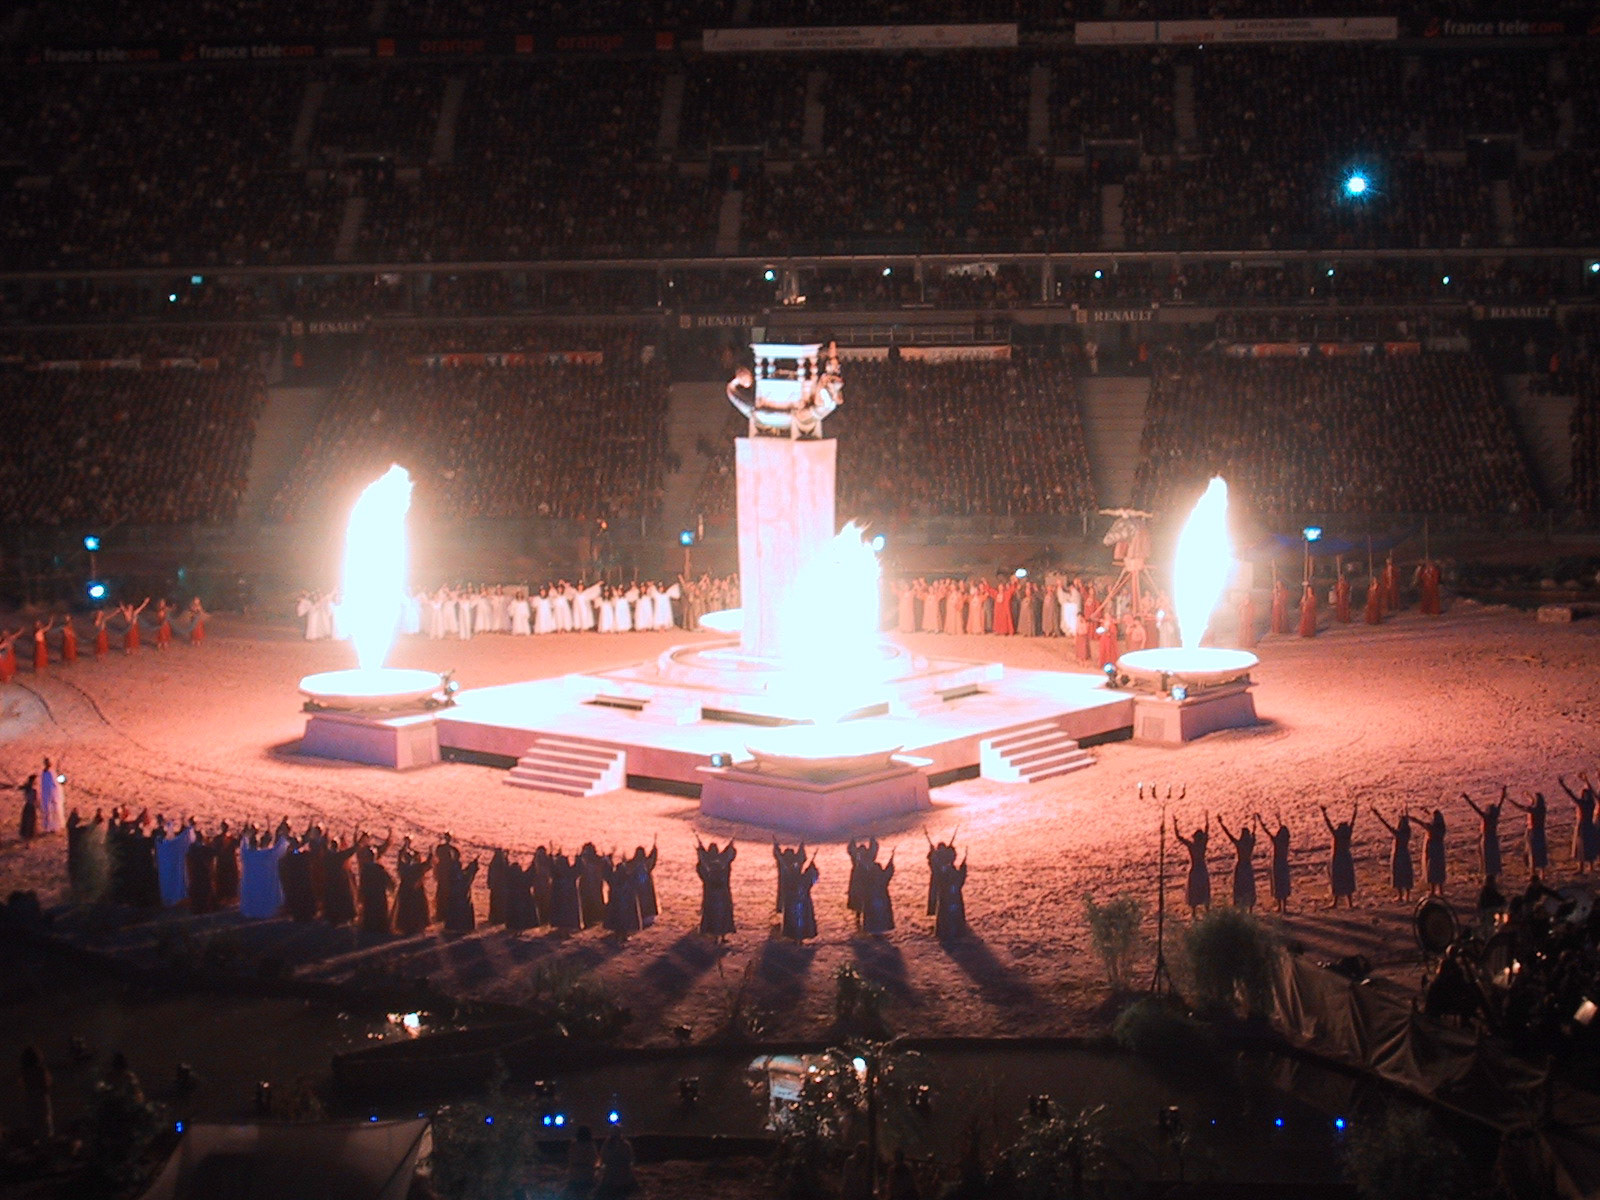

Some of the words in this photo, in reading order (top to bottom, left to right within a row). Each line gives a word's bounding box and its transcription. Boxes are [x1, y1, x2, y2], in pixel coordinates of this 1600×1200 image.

[1443, 19, 1494, 34] france
[1498, 19, 1565, 34] telecom
[199, 45, 248, 59] france
[251, 44, 316, 58] telecom
[419, 39, 485, 55] orange
[556, 35, 623, 53] orange
[1093, 310, 1153, 322] RENAULT
[1490, 306, 1551, 318] RENAULT
[697, 315, 757, 326] RENAULT
